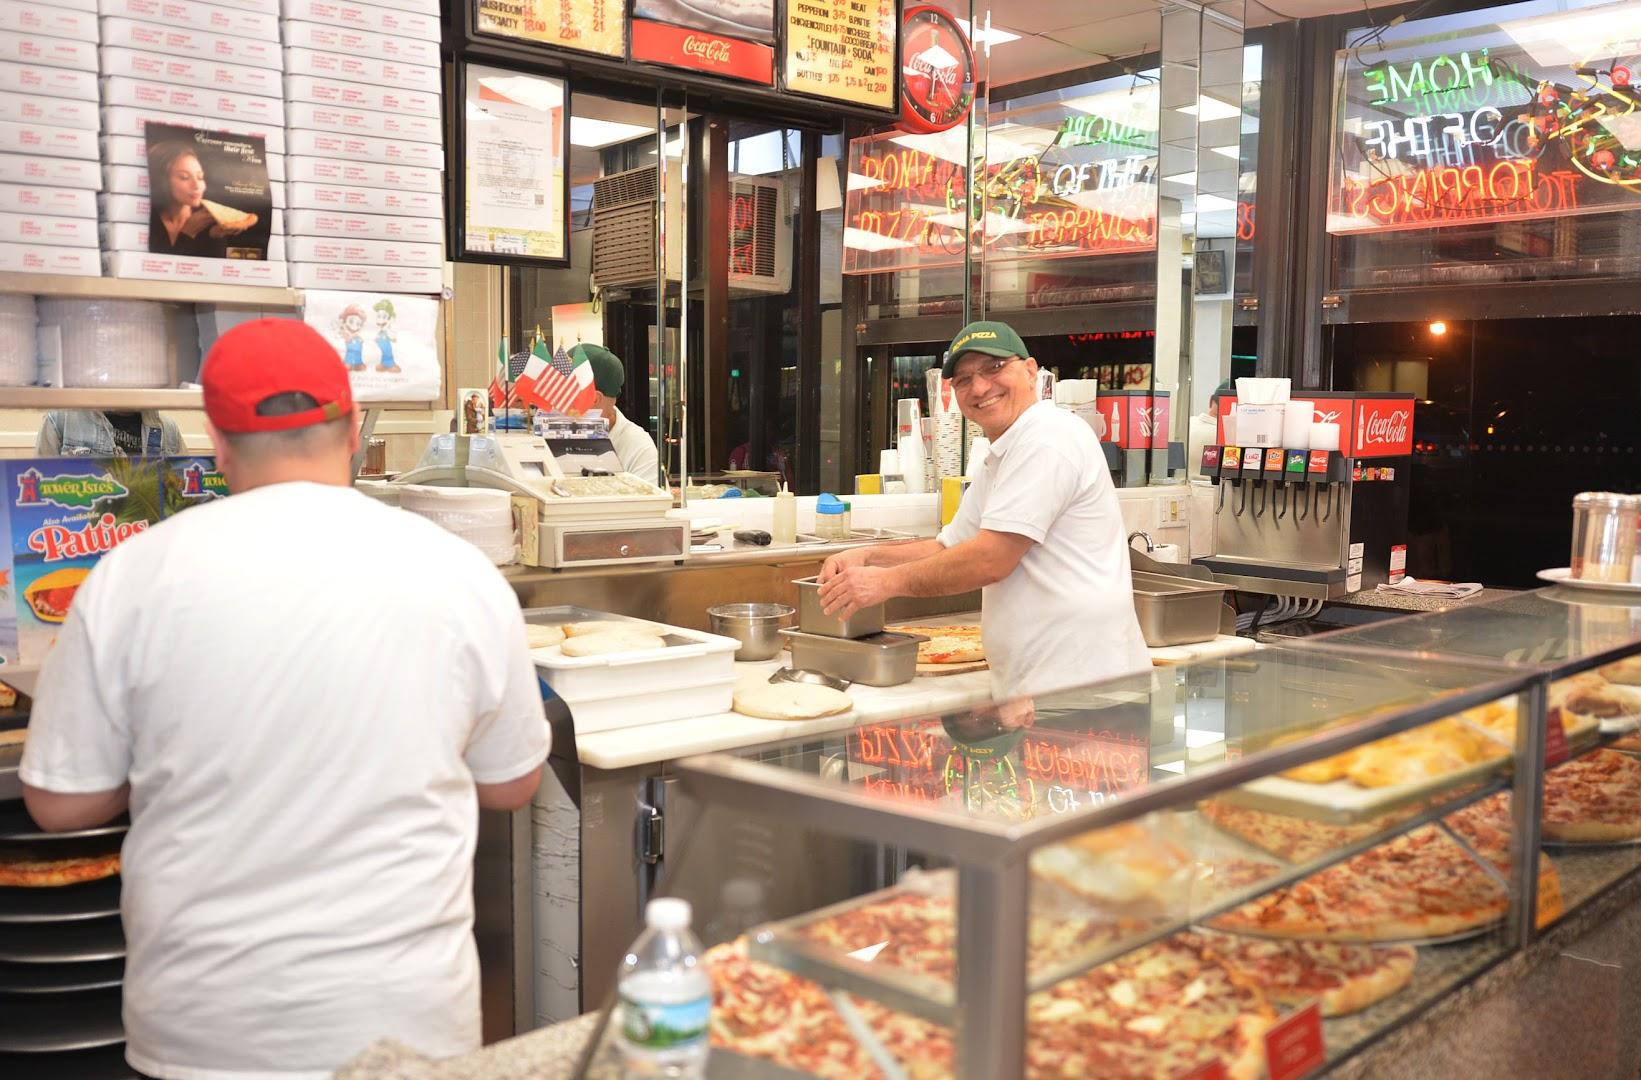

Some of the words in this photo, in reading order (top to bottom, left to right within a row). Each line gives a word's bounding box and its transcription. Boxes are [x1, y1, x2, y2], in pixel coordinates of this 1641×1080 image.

[930, 13, 938, 24] 12
[683, 35, 731, 62] Coca-Cola
[811, 37, 847, 55] FOUNTAIN
[853, 47, 872, 61] SODA
[965, 72, 971, 82] 3
[930, 113, 936, 123] 6
[971, 331, 997, 339] PIZZA
[1366, 410, 1409, 444] Coca-Cola
